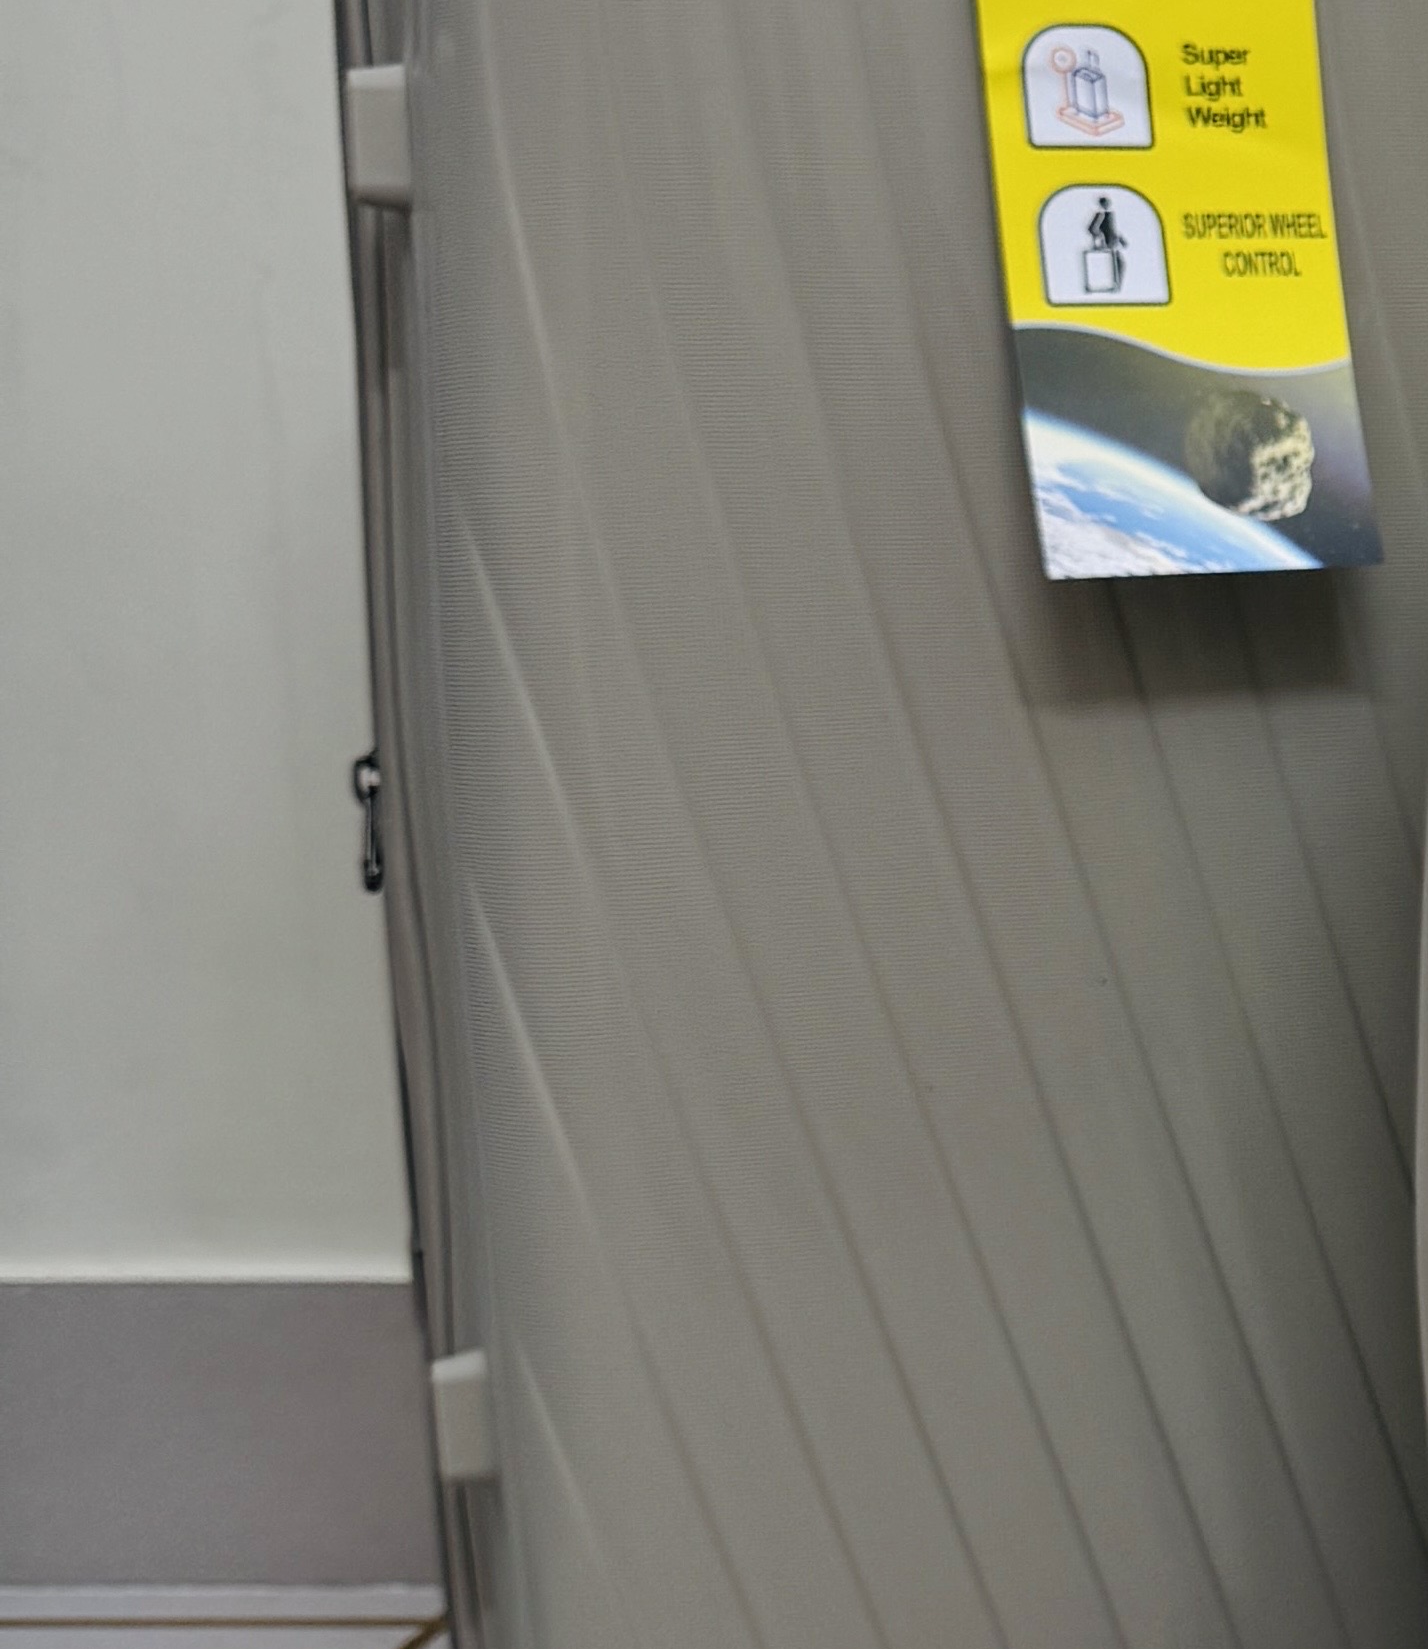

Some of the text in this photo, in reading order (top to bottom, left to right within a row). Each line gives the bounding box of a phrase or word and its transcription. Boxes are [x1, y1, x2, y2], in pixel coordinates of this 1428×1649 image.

[1181, 43, 1249, 69] Super
[1184, 75, 1243, 102] Light
[1186, 106, 1266, 131] Weight
[1182, 212, 1327, 240] SUPERIOR WHEEL
[1222, 250, 1301, 278] CONTROL
